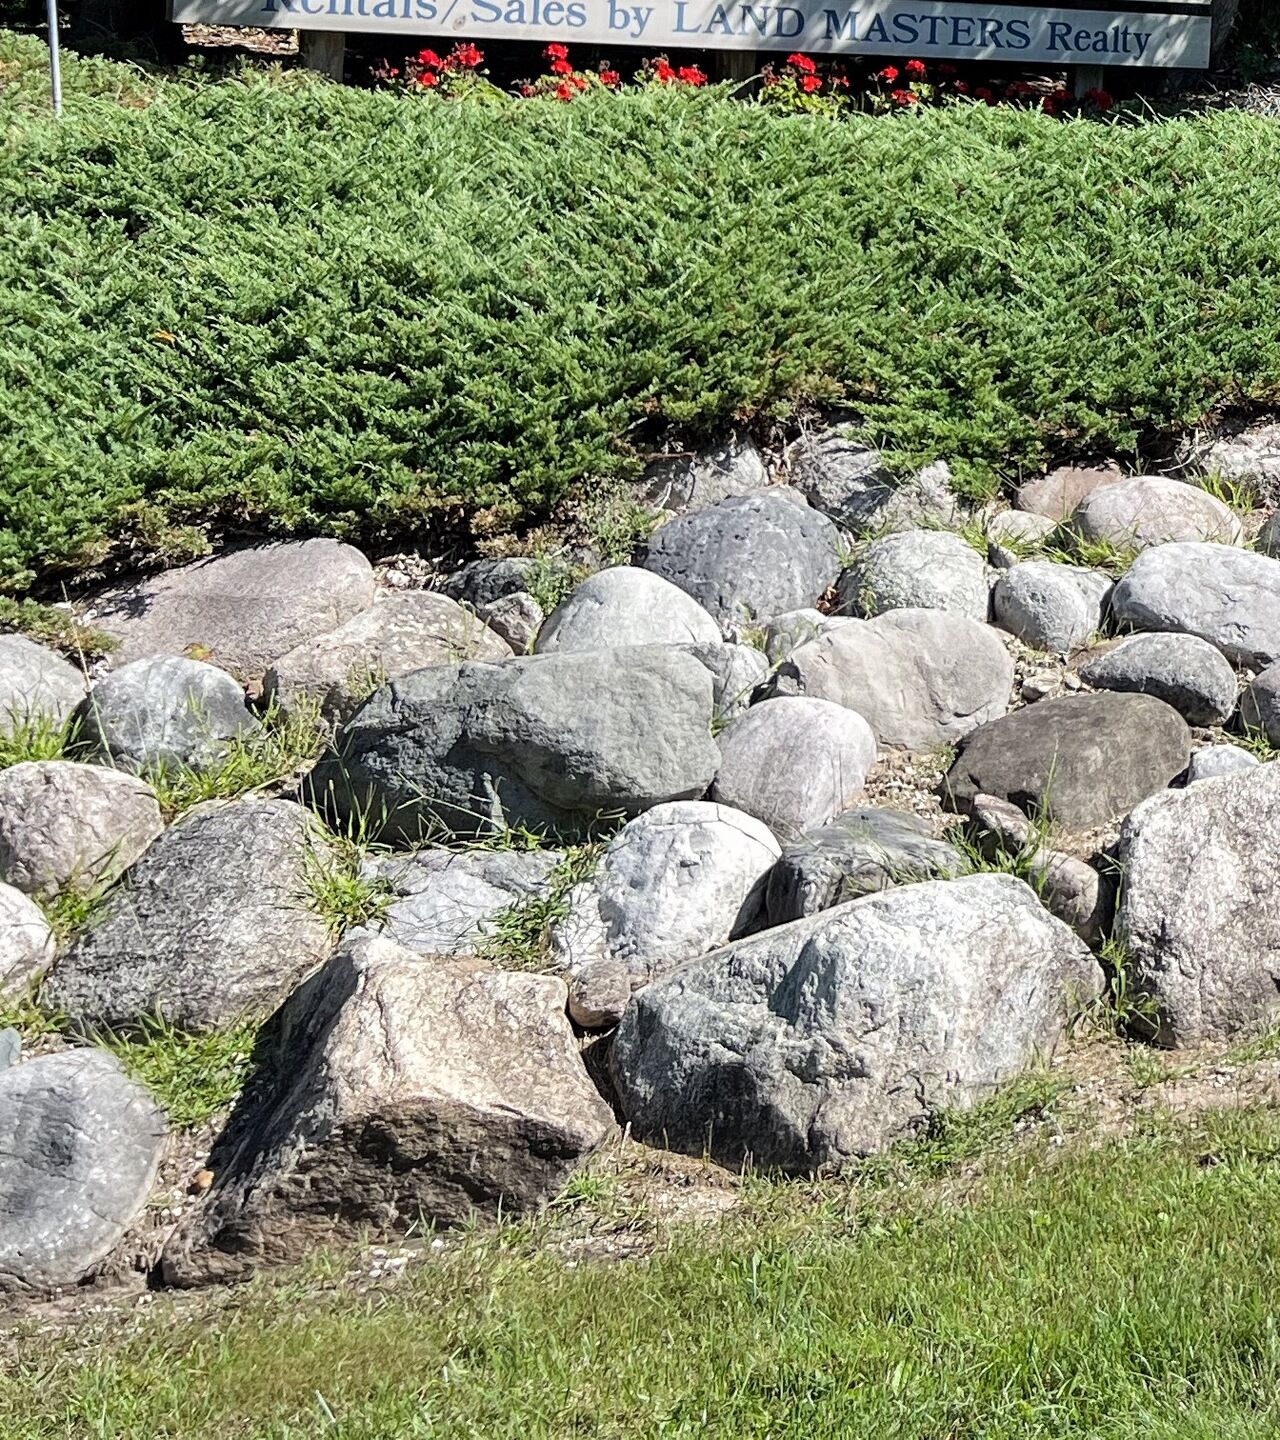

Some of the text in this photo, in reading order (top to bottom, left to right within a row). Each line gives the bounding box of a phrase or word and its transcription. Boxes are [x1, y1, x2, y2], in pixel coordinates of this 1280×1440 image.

[672, 0, 805, 38] LAND
[822, 9, 1031, 49] MASTERS
[1046, 21, 1152, 60] Realty
